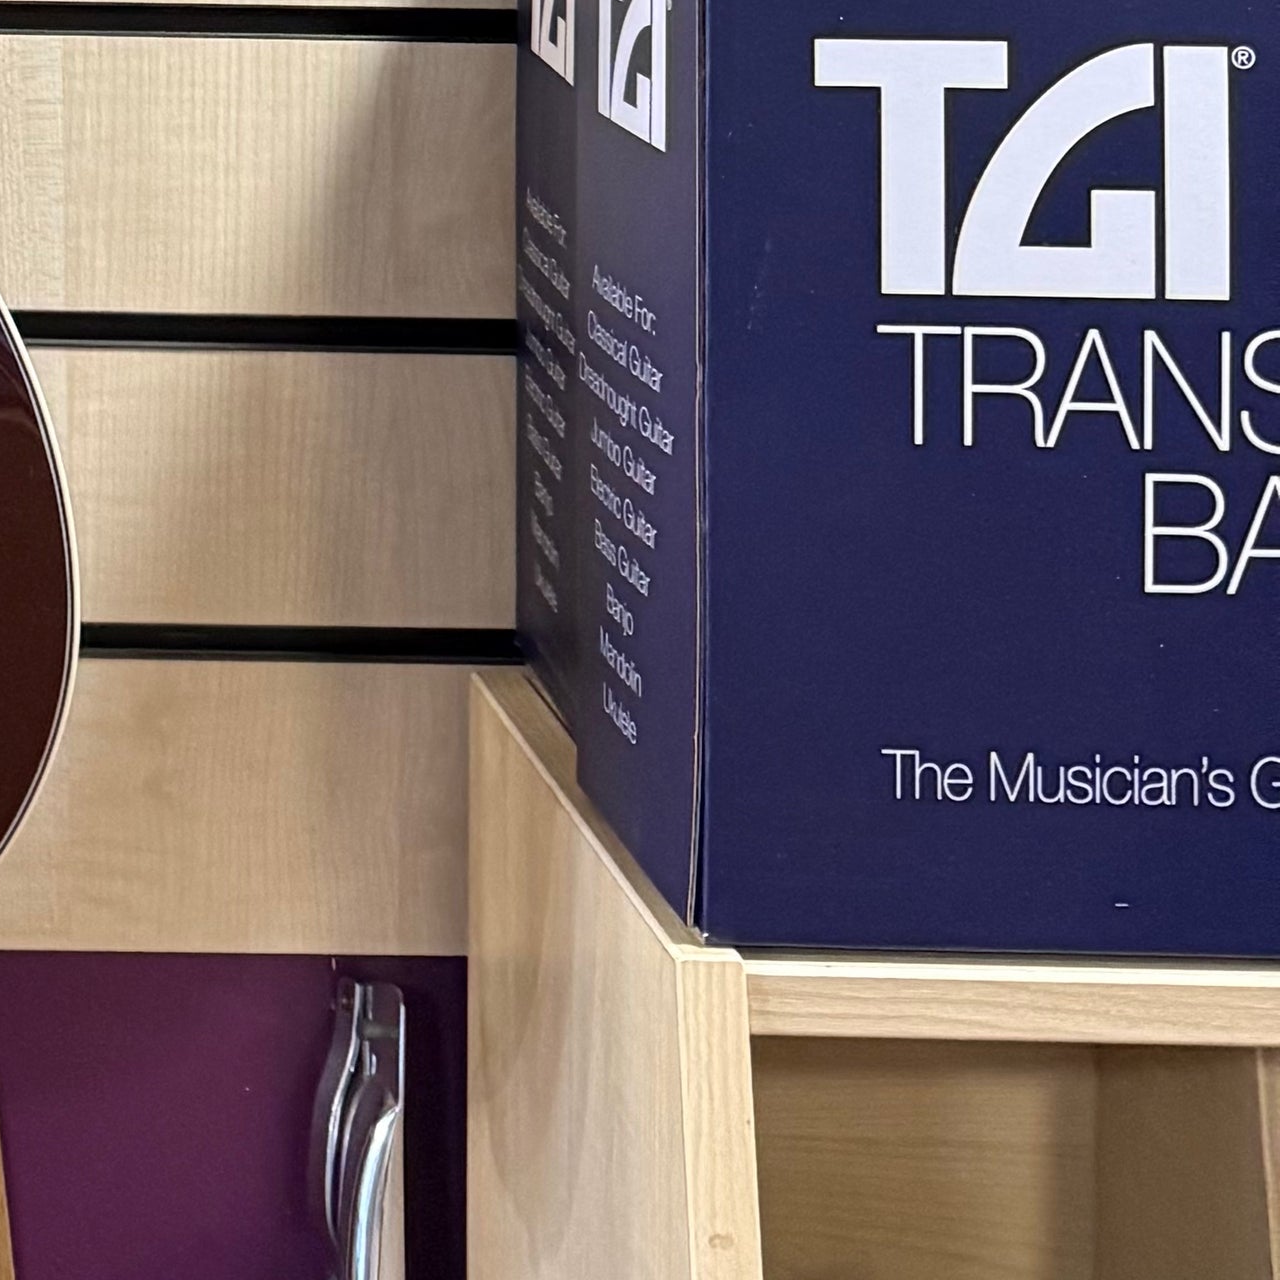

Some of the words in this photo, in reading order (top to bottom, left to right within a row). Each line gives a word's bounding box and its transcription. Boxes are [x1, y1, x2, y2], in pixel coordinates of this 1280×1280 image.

[592, 264, 633, 319] Available
[587, 309, 628, 369] Classical
[629, 345, 664, 394] Guitar
[591, 416, 621, 467] Jumbo
[622, 445, 657, 496] Guitar
[638, 406, 675, 456] Guitar
[590, 462, 621, 520] Electric
[623, 498, 658, 550] Guitar
[594, 517, 617, 567] Bass
[617, 545, 651, 597] Guitar
[606, 582, 634, 637] Banjo
[600, 624, 642, 698] Mandolin
[603, 681, 638, 744] Ukulele
[881, 748, 974, 802] The
[990, 750, 1235, 808] Musician's
